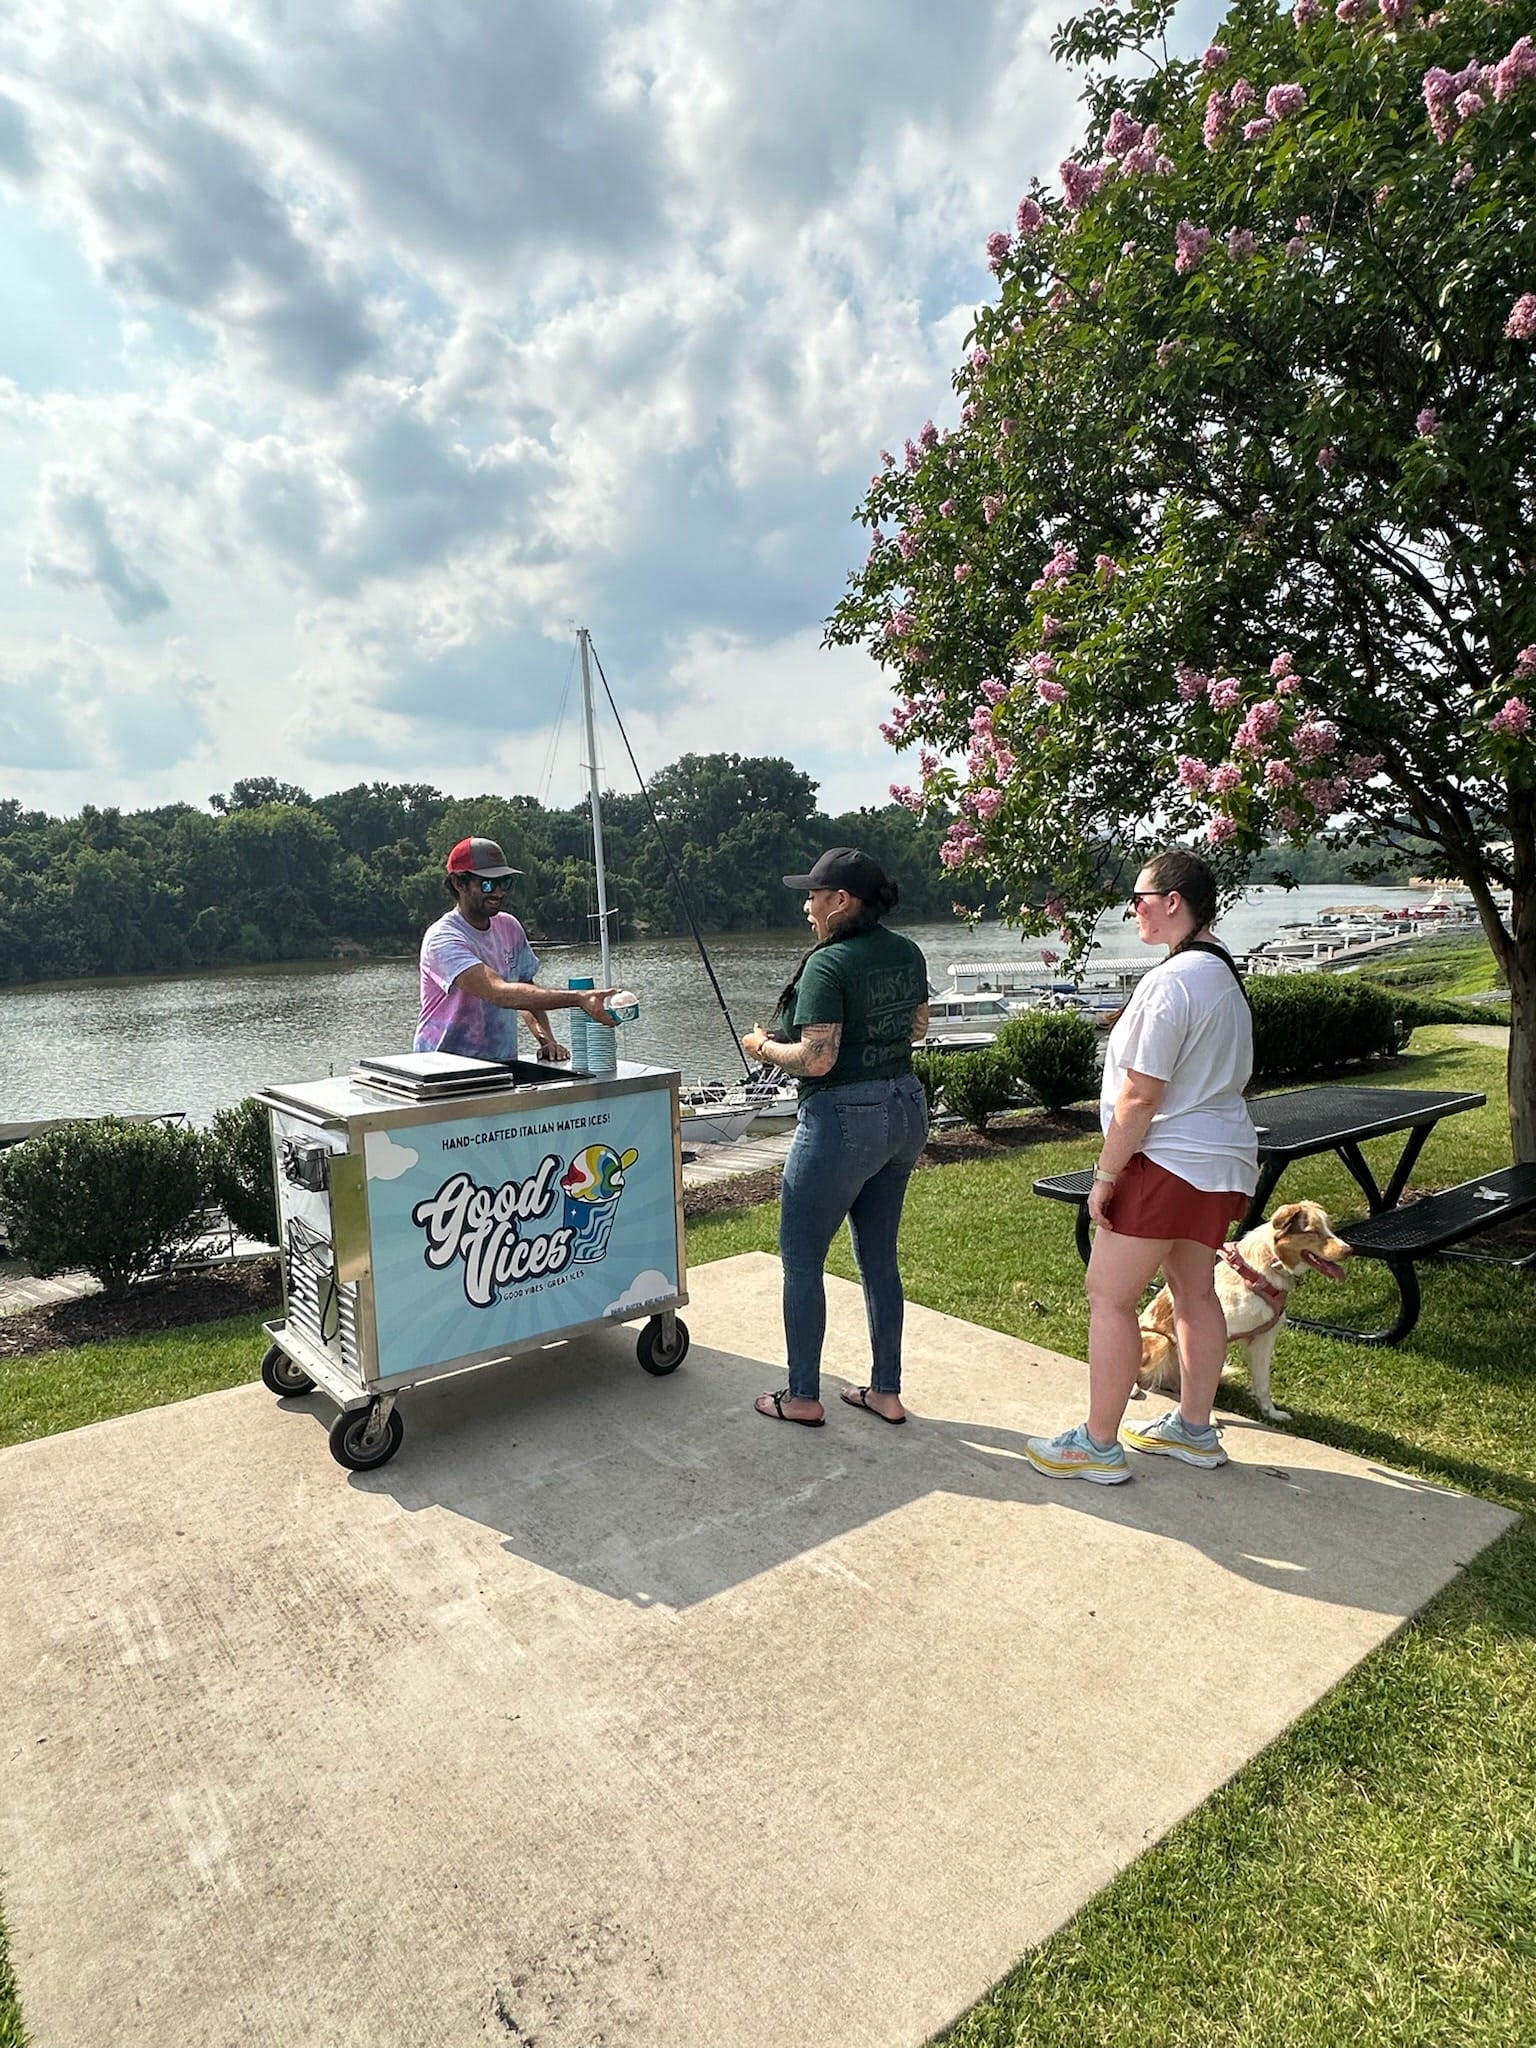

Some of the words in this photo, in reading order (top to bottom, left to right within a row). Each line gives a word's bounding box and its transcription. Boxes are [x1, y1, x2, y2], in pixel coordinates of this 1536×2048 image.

[441, 1127, 518, 1151] HAND-CRAFTED
[519, 1122, 554, 1138] ITALIAN
[556, 1117, 587, 1132] WATER
[588, 1113, 611, 1127] ICES!
[414, 1156, 558, 1267] Good
[459, 1220, 575, 1306] Vices
[503, 1289, 524, 1301] GOOD
